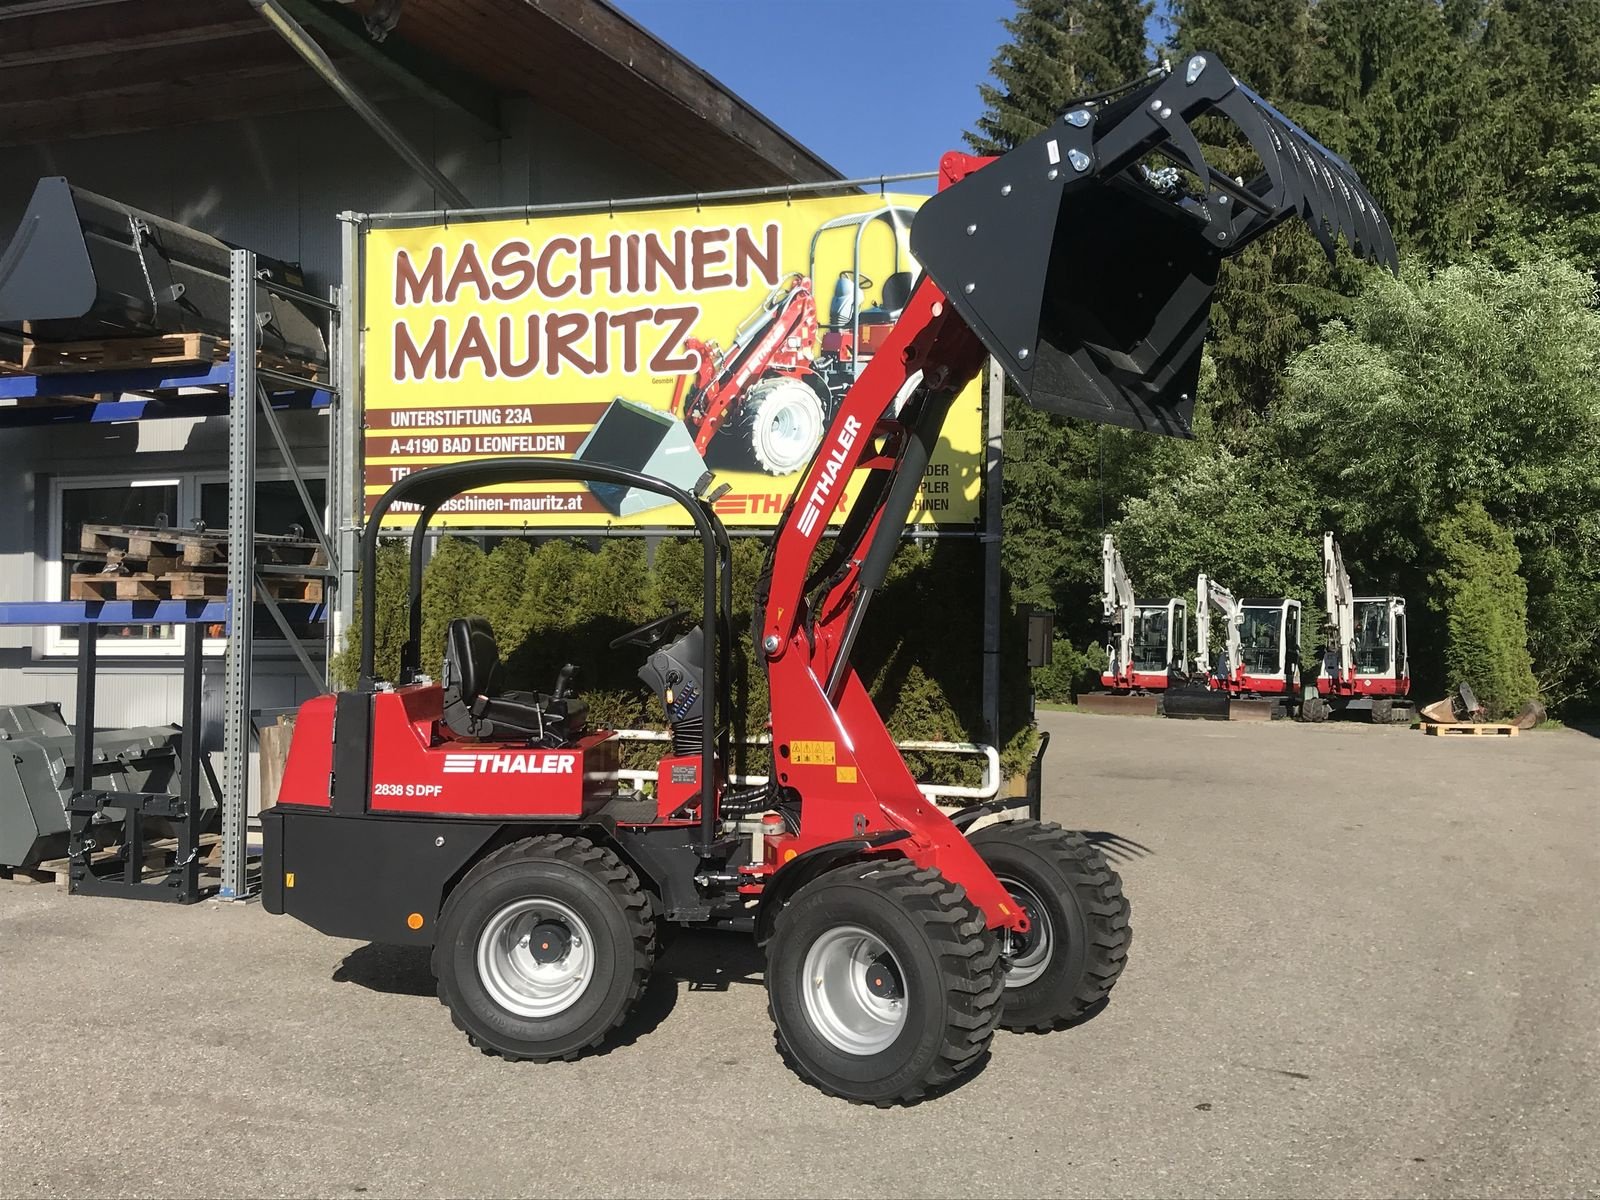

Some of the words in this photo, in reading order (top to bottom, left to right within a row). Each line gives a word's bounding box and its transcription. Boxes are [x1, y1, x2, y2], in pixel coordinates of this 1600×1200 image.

[395, 224, 779, 305] MASCHINEN
[395, 306, 699, 380] MAURITZ
[391, 409, 501, 427] UNTERSTIFTUNG
[505, 408, 532, 424] 23A
[390, 439, 438, 454] A-4190
[443, 438, 471, 453] BAD
[475, 435, 565, 452] LEONFELDEN
[809, 415, 862, 506] THALER
[477, 754, 575, 774] THALER
[374, 784, 403, 796] 2838
